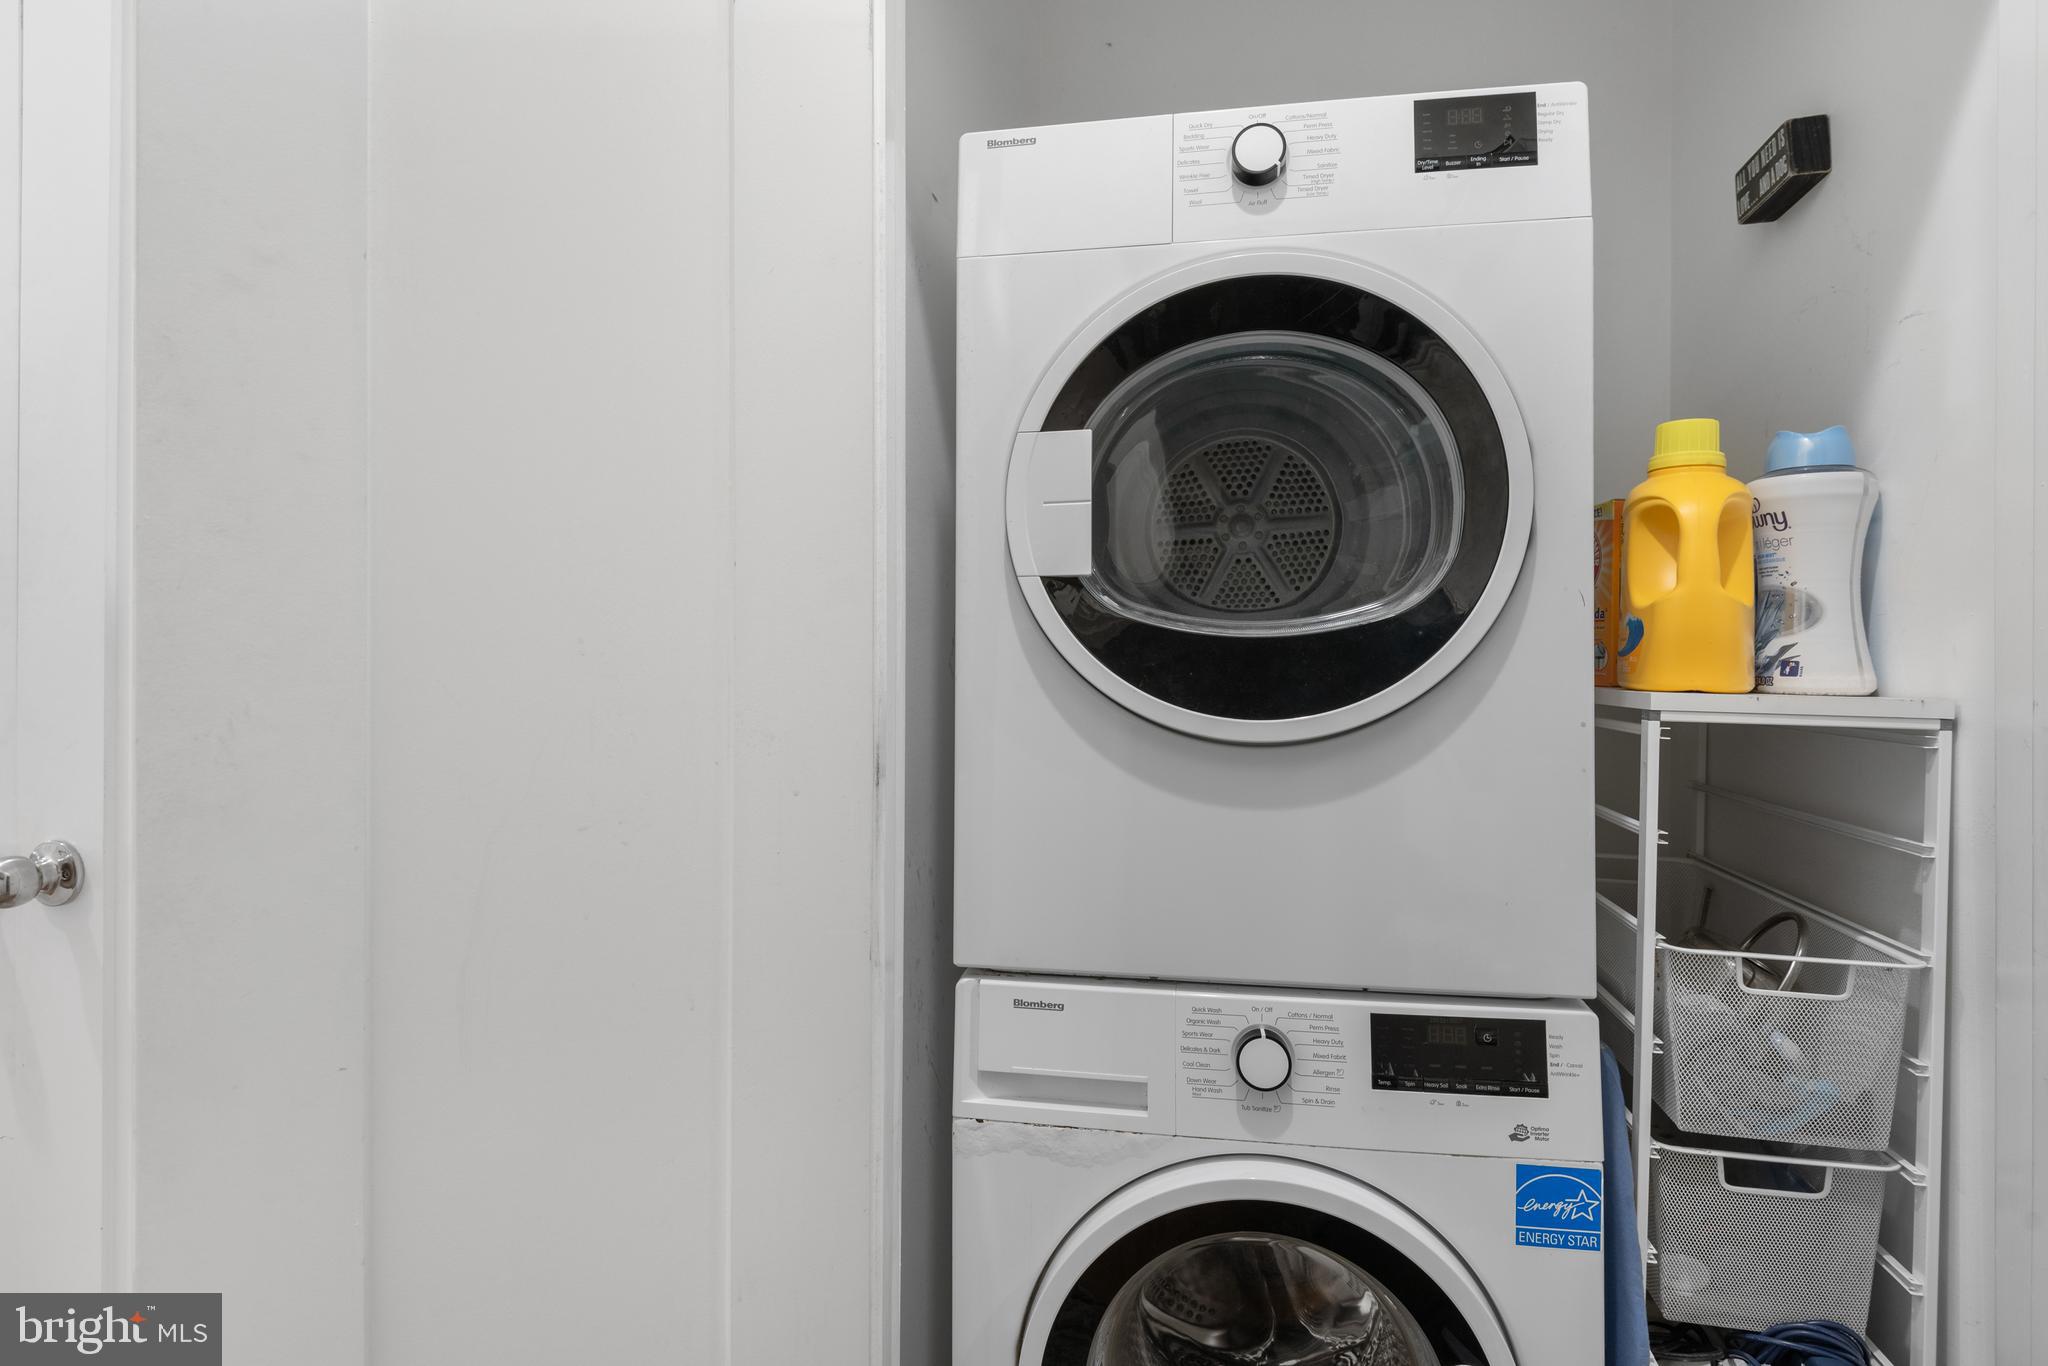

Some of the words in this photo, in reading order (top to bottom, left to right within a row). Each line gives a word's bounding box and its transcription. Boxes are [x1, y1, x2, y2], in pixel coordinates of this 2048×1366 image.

[986, 137, 1036, 149] Blomberg
[1736, 169, 1747, 195] ALL
[1747, 154, 1760, 181] YOU
[1760, 137, 1777, 168] NEED
[1778, 128, 1785, 150] IS
[1752, 511, 1788, 532] wny
[1594, 608, 1605, 619] da
[1013, 998, 1065, 1012] Blomberg
[1186, 1017, 1206, 1025] Organic
[1312, 1037, 1330, 1045] Heavy
[1331, 1038, 1344, 1046] Duty
[1180, 1045, 1203, 1053] Delicates
[1312, 1052, 1330, 1060] Mixed
[1330, 1053, 1347, 1061] Fabric
[1312, 1068, 1336, 1077] Allergen
[1301, 1097, 1315, 1105] Spin
[1517, 1198, 1577, 1220] energy
[1518, 1231, 1566, 1246] ENERGY
[1567, 1234, 1598, 1248] STAR
